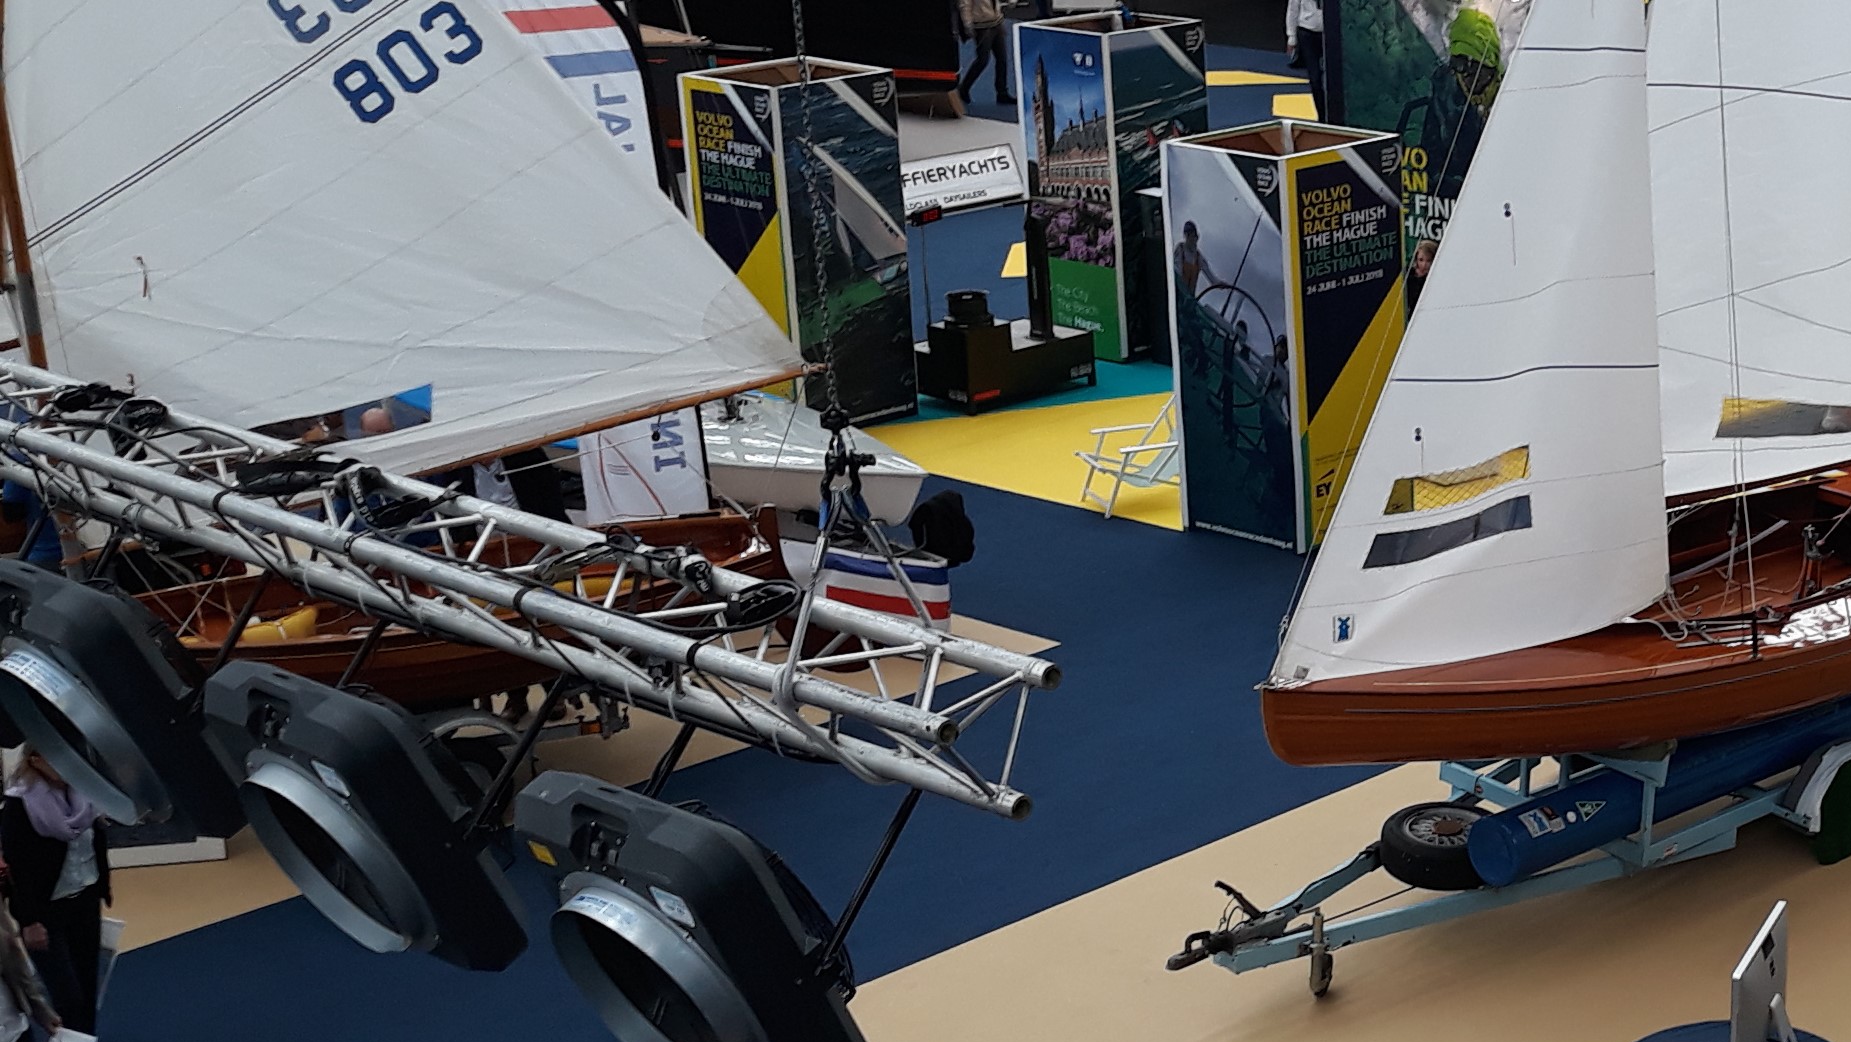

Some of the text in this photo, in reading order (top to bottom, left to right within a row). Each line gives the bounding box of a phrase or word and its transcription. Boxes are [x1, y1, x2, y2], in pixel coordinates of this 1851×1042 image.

[333, 1, 483, 124] 803
[696, 111, 733, 128] VOLVO
[700, 149, 756, 170] THE HAGUE
[727, 141, 762, 158] FINISH
[901, 155, 1010, 188] FFIERYACHTS
[1302, 183, 1352, 206] VOLVO
[1303, 199, 1352, 220] OCEAN
[1304, 205, 1387, 236] RACE FINISH
[1304, 221, 1378, 250] THE HAGUE
[1305, 231, 1397, 264] THE ULTIMATE
[1306, 246, 1393, 279] DESTINATION
[1316, 482, 1332, 498] EY
